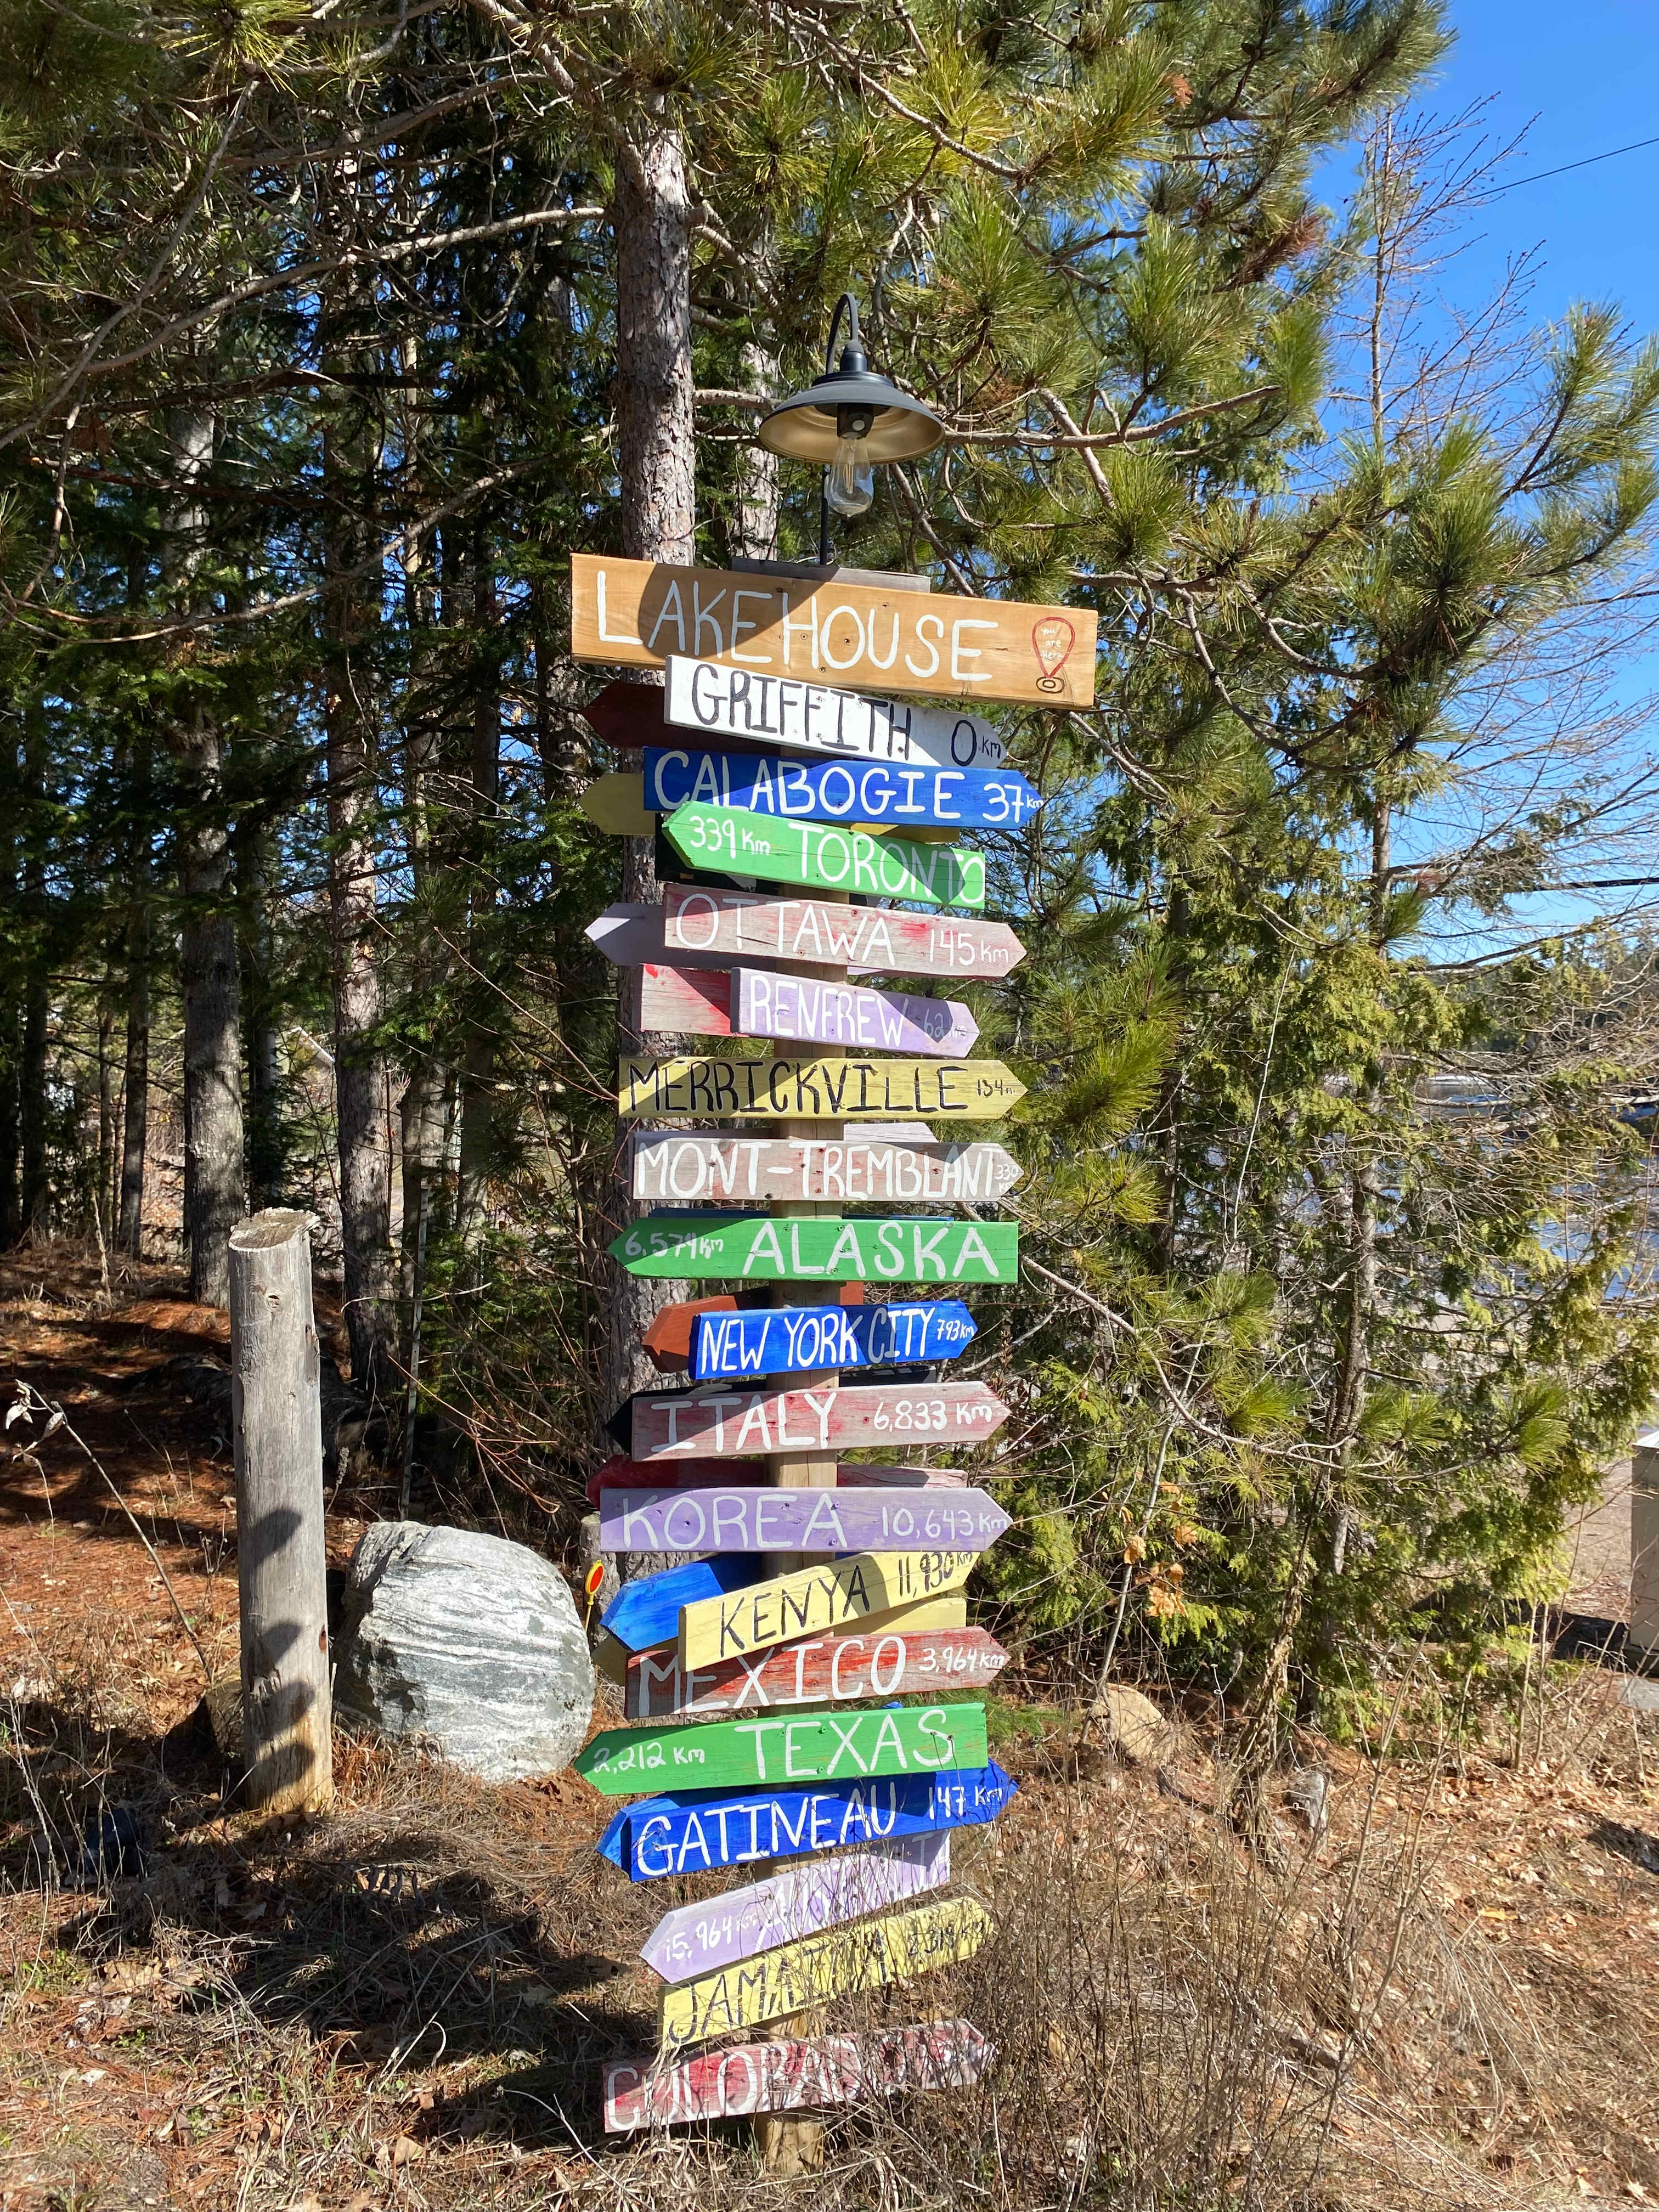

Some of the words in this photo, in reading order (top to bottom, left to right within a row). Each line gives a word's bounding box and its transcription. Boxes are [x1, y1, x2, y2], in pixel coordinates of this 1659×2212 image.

[597, 570, 998, 681] LAKEHOUSE
[692, 663, 912, 759] GRIFFITH
[654, 750, 965, 819] CALABOGIE
[788, 822, 985, 904] TORONTO
[676, 893, 895, 966] OTTAWA
[748, 974, 909, 1048] RENFREW
[628, 1061, 968, 1113] MERRICKVILLE
[637, 1141, 1005, 1199] MONT-TREMBLANT
[743, 1221, 1000, 1279] ALASKA
[701, 1317, 771, 1374] NEW
[786, 1310, 864, 1367] YORK
[868, 1307, 935, 1364] CITY
[651, 1392, 837, 1453] ITALY
[622, 1492, 848, 1551] KOREA
[721, 1564, 870, 1657] KENYA
[639, 1636, 906, 1718] MEXICO
[734, 1709, 953, 1780] TEXAS
[637, 1782, 896, 1877] GATINEAU
